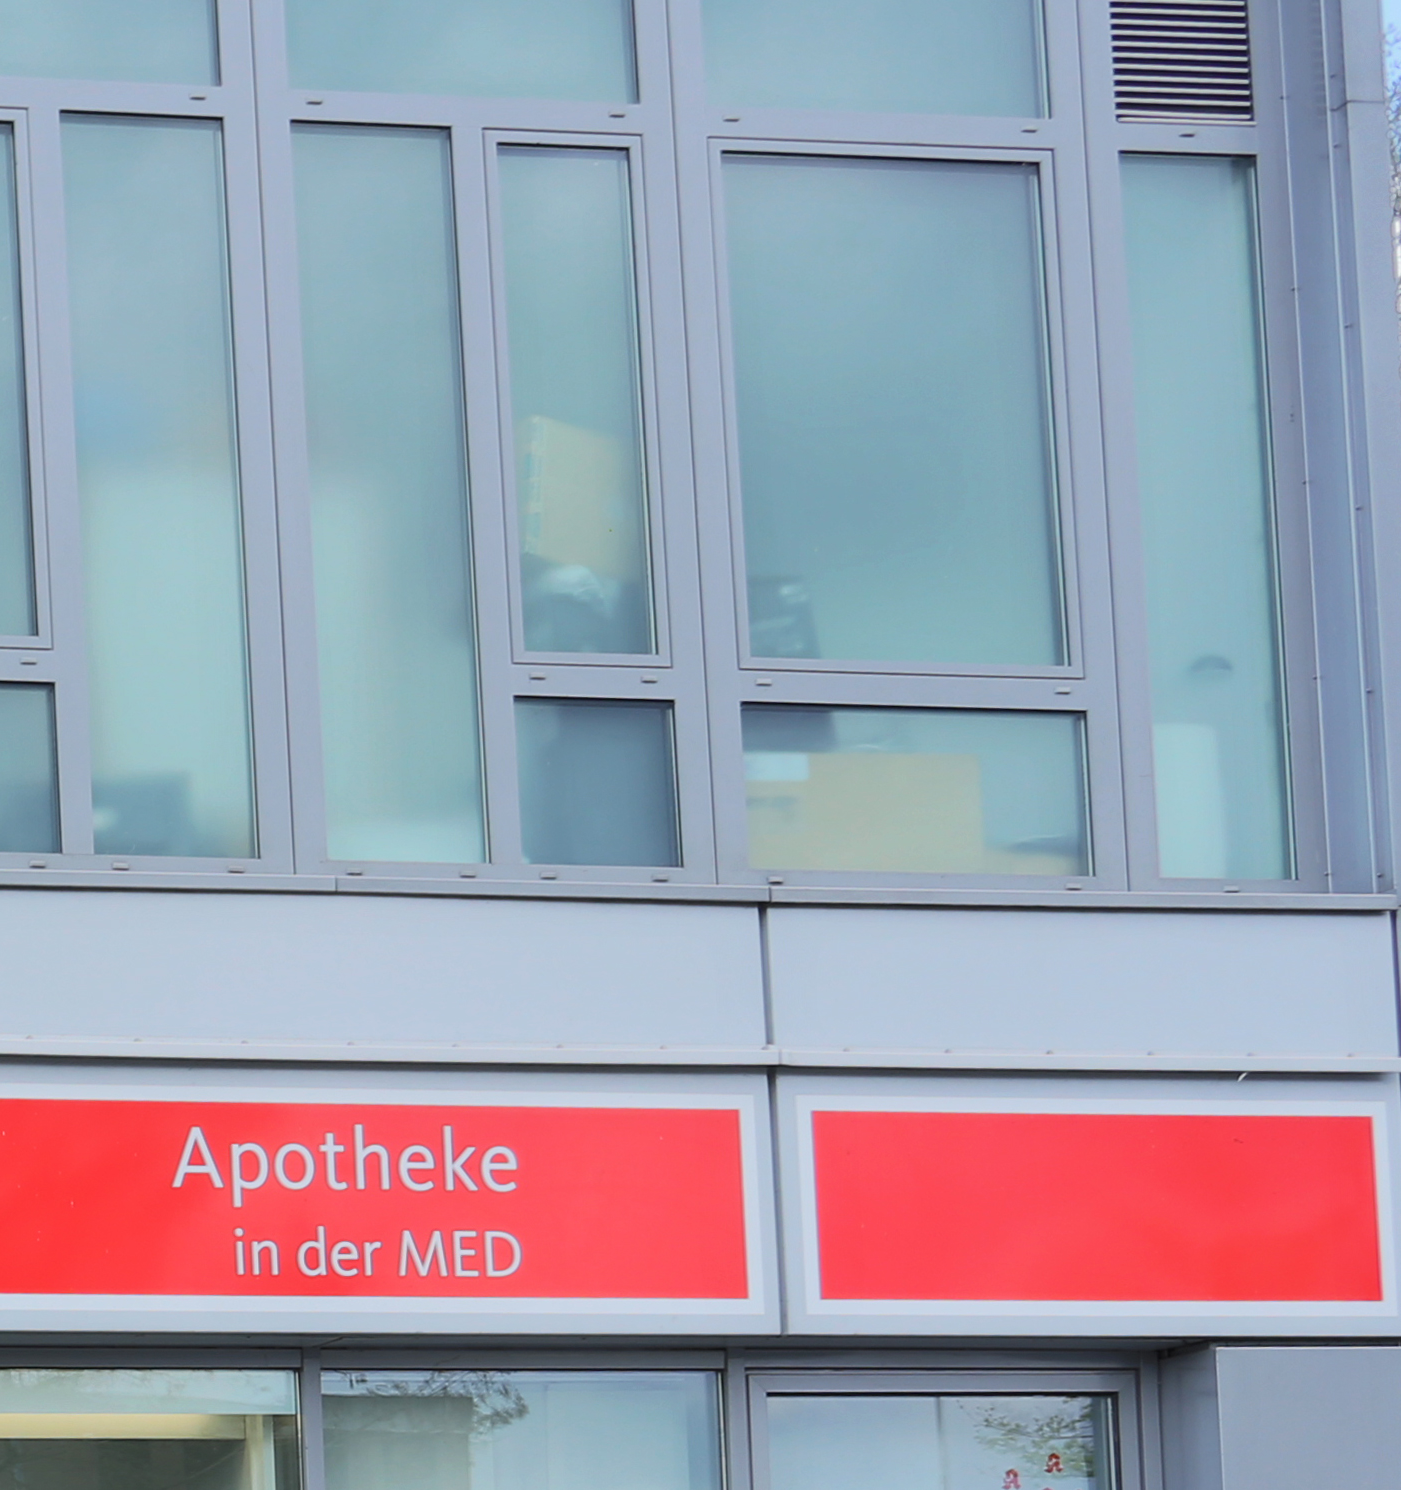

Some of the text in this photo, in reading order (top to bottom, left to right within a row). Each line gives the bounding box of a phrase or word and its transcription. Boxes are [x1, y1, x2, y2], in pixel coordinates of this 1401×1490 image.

[171, 1123, 518, 1208] Apotheke
[233, 1225, 522, 1278] in der MED
